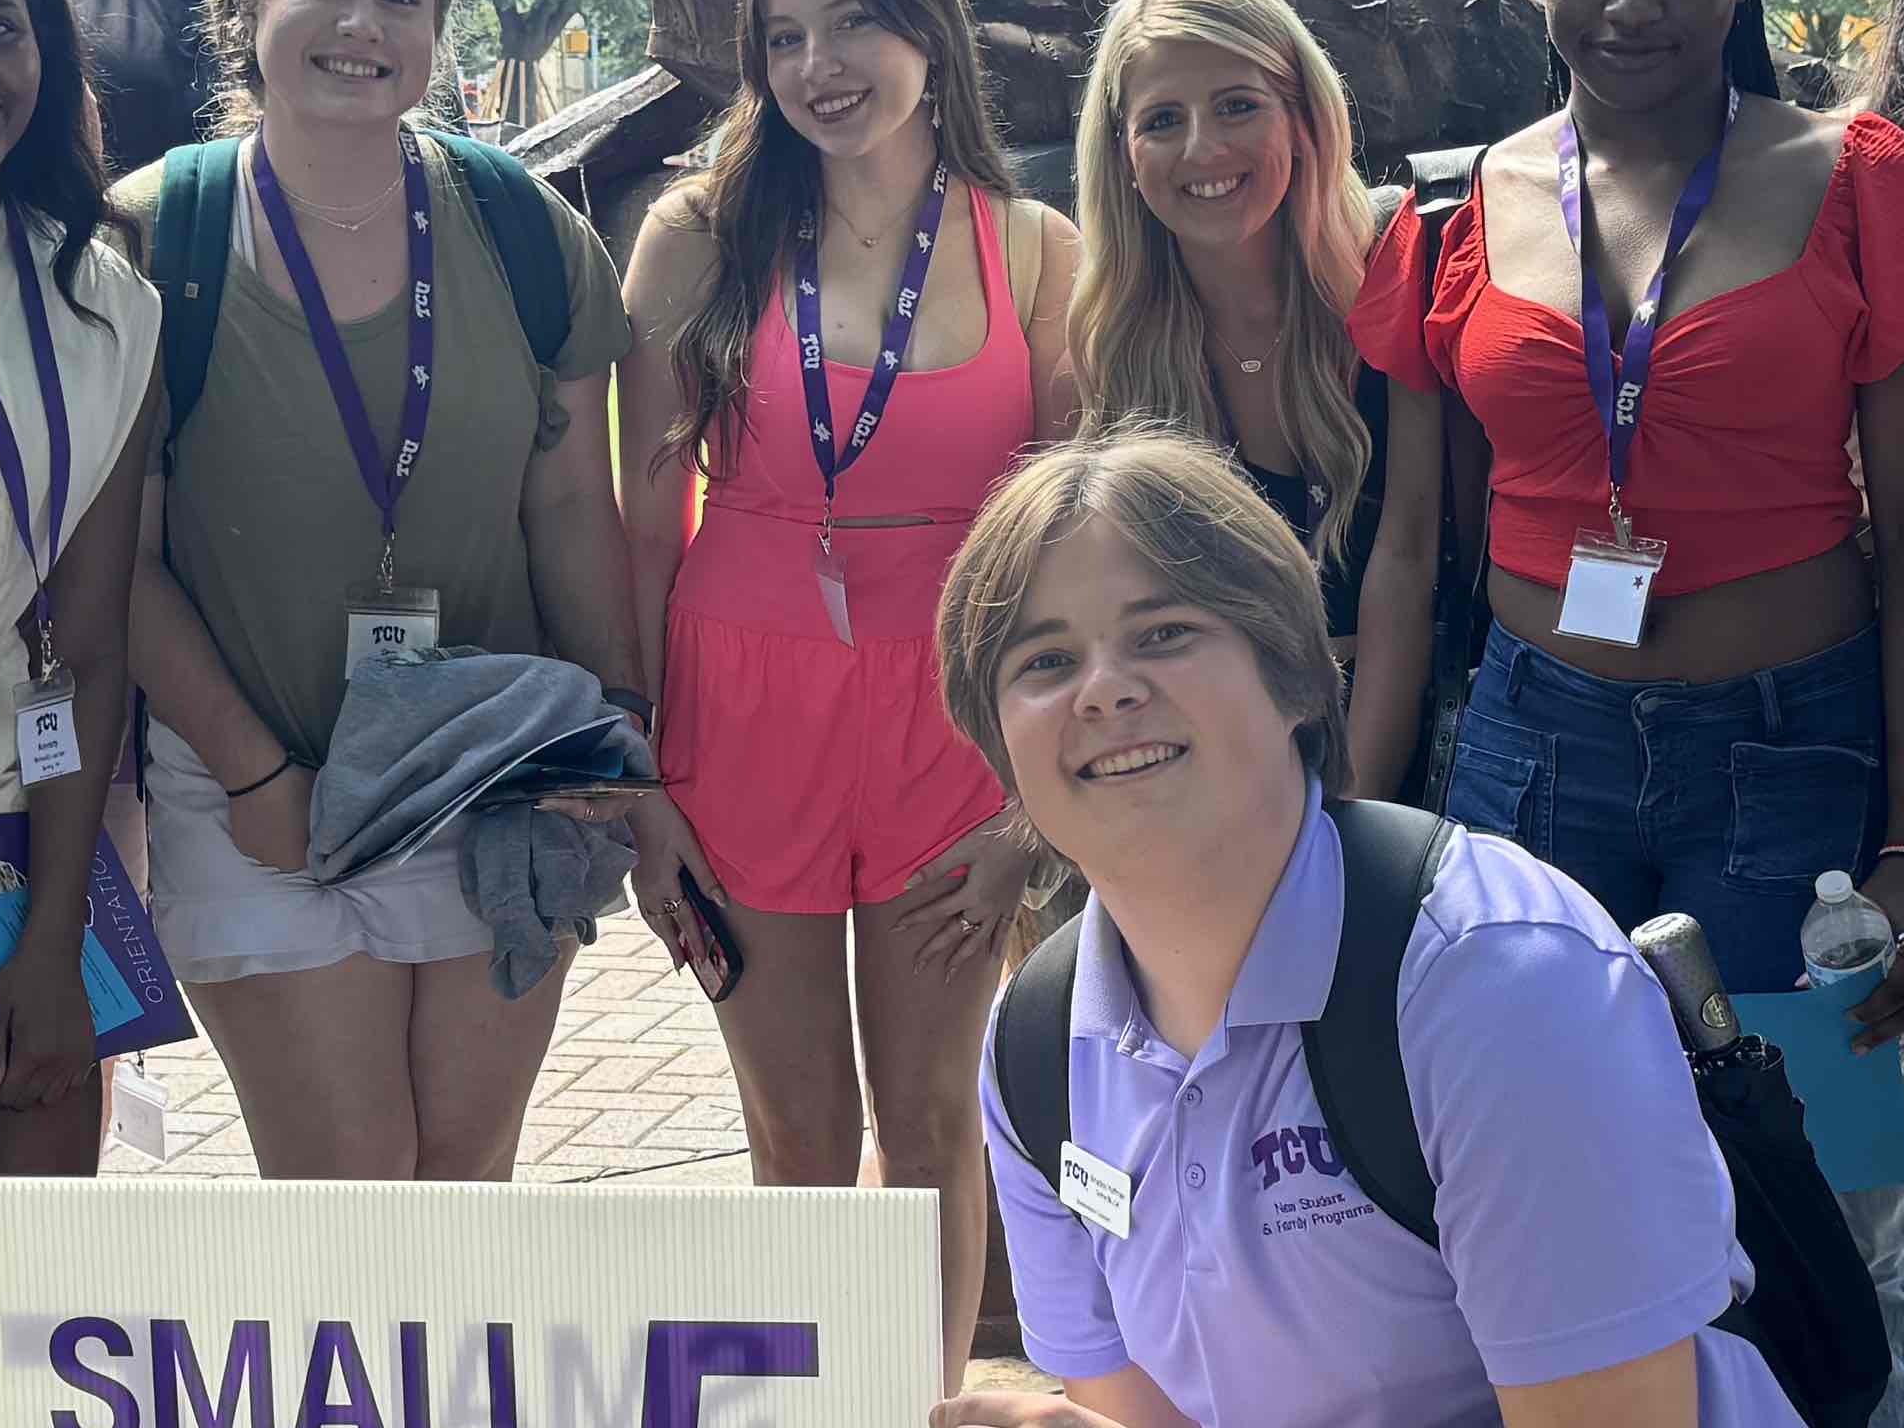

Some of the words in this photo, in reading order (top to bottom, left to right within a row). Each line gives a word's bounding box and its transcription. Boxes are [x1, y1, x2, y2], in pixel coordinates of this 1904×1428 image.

[399, 131, 421, 165] TCU
[415, 281, 432, 319] TCU
[897, 287, 918, 319] TCU
[801, 334, 821, 370] TCU
[1617, 381, 1642, 426] TCU
[851, 411, 878, 448] TCU
[396, 439, 420, 477] TCU
[372, 625, 406, 645] TCU
[36, 712, 58, 736] TCU
[92, 850, 164, 1003] ORIENTATIO
[1064, 1159, 1089, 1188] TCU
[1250, 1124, 1346, 1191] TCU
[1262, 1222, 1273, 1236] &
[1311, 1203, 1376, 1226] Programs
